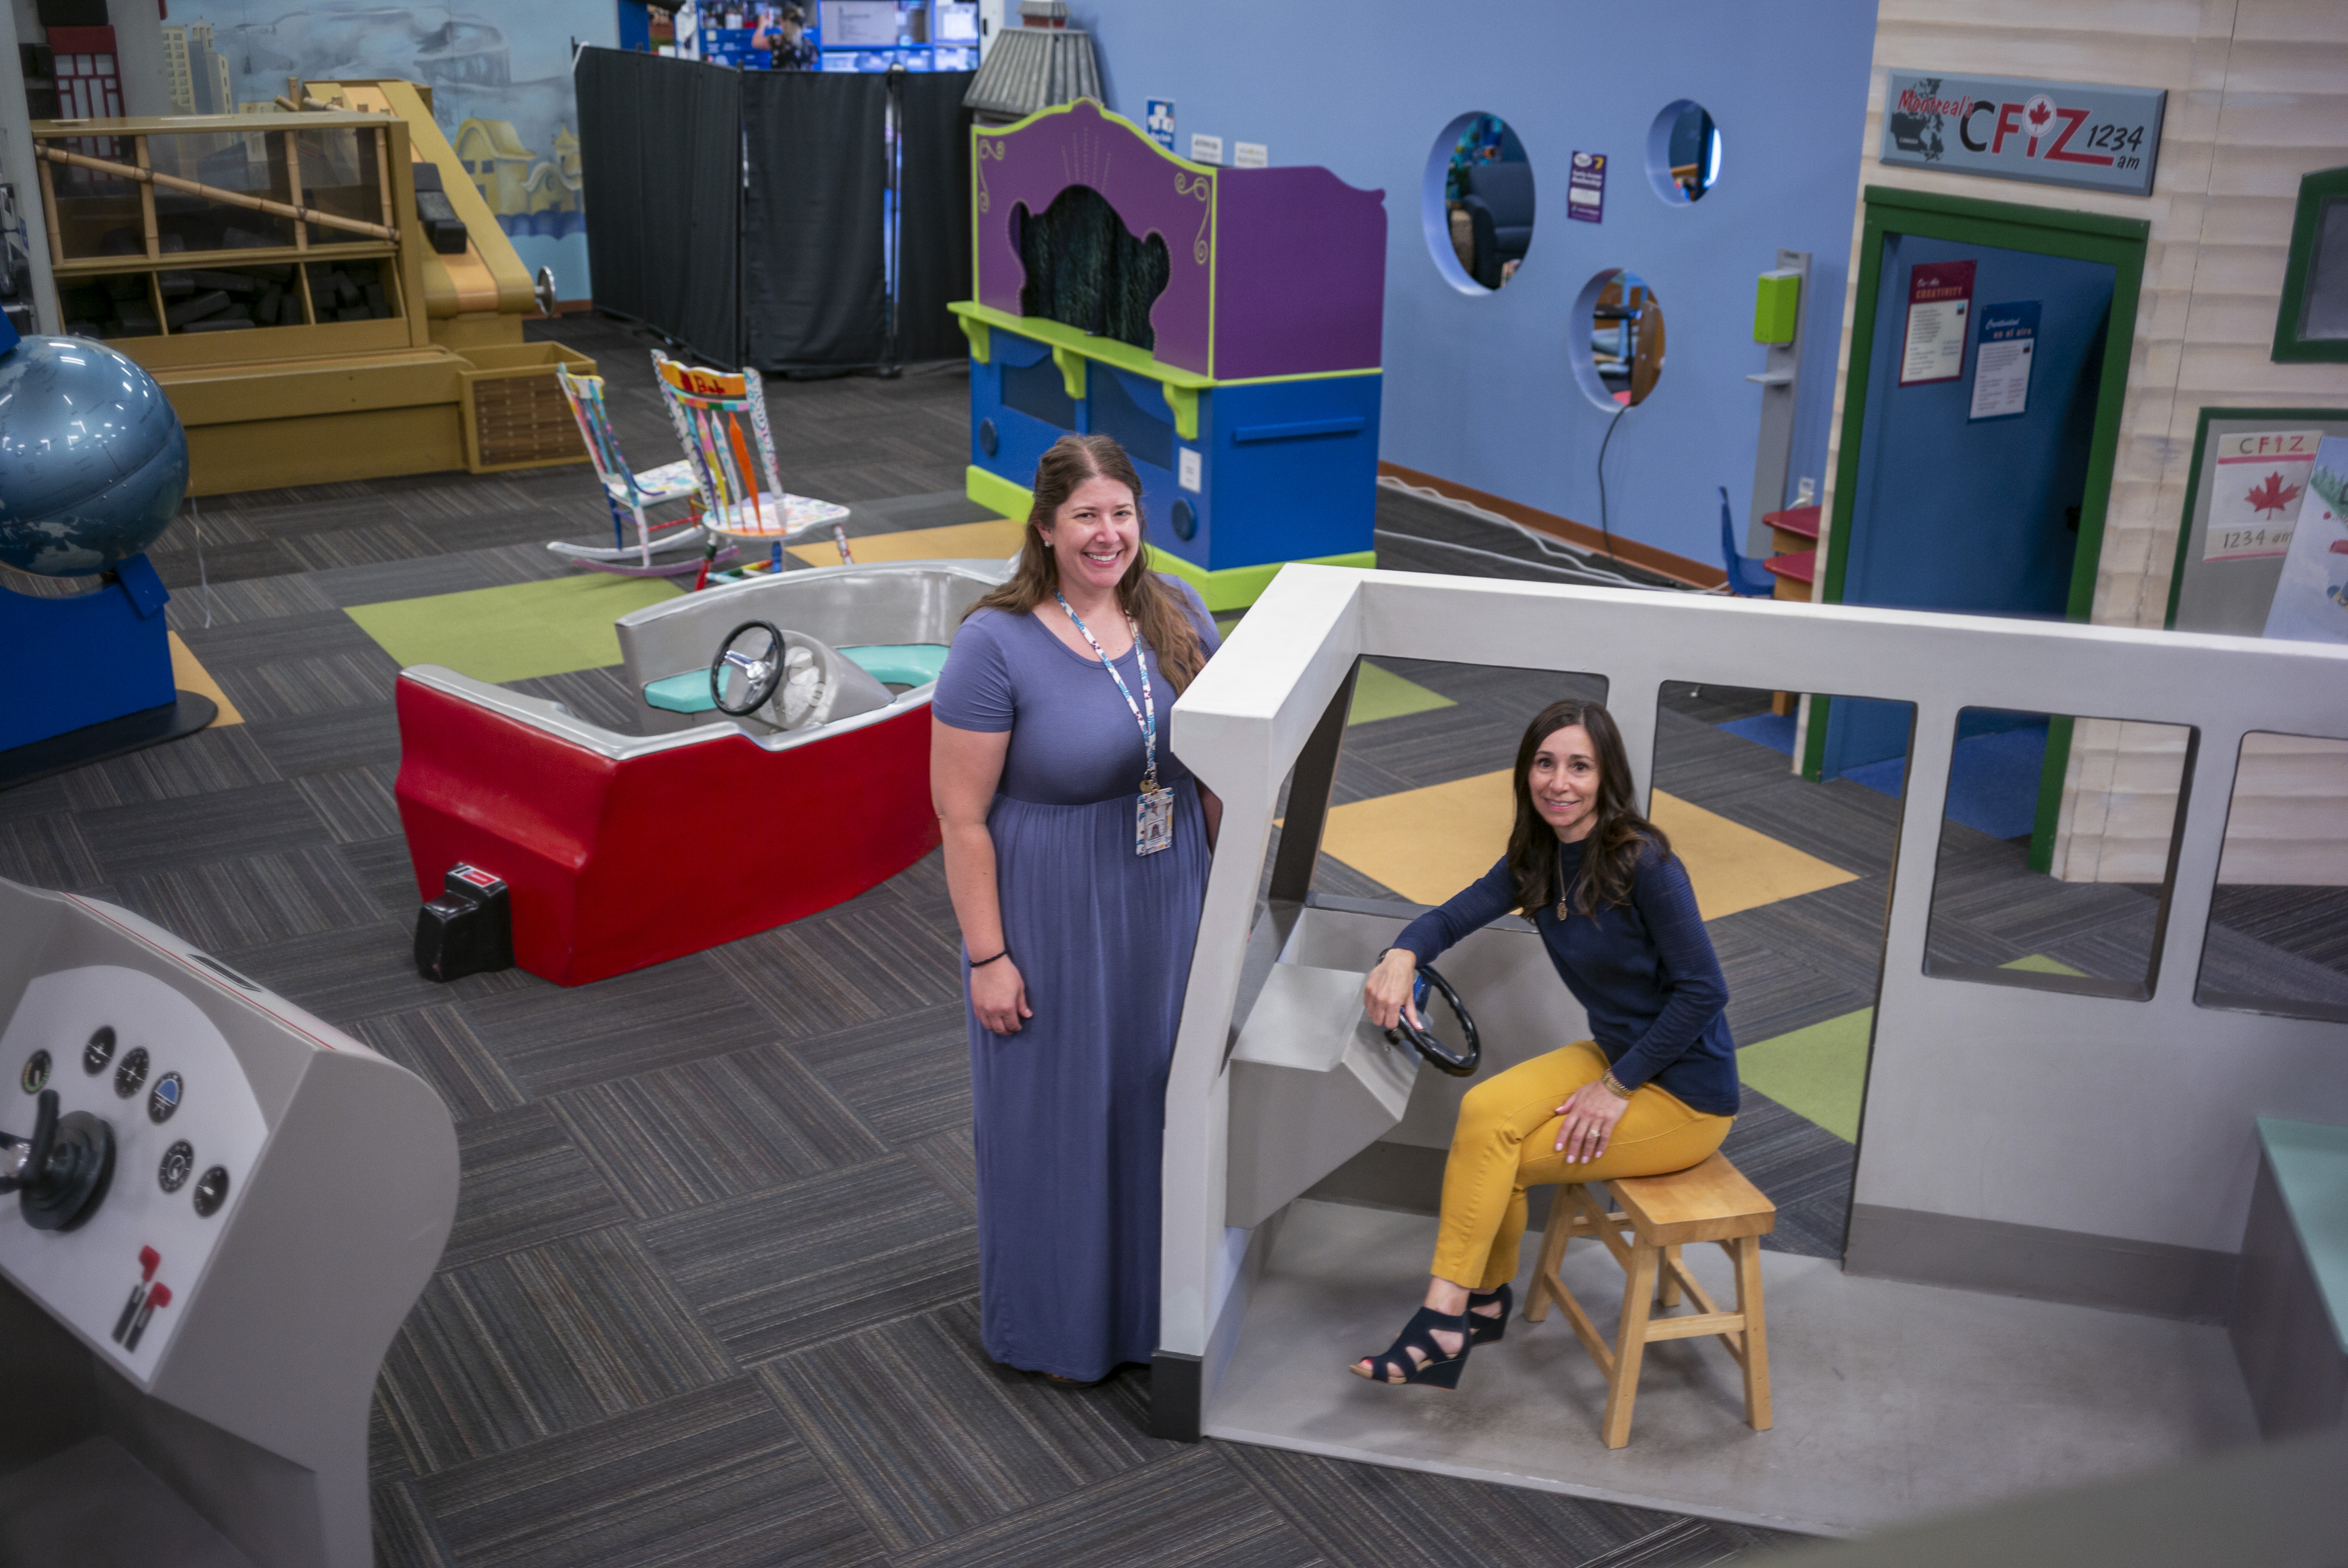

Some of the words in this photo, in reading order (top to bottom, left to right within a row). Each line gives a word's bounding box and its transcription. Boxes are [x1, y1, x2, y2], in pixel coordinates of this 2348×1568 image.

[1897, 89, 1974, 117] Montreal's
[2087, 125, 2144, 152] 1234
[2117, 156, 2140, 170] am
[2223, 529, 2265, 548] 1234
